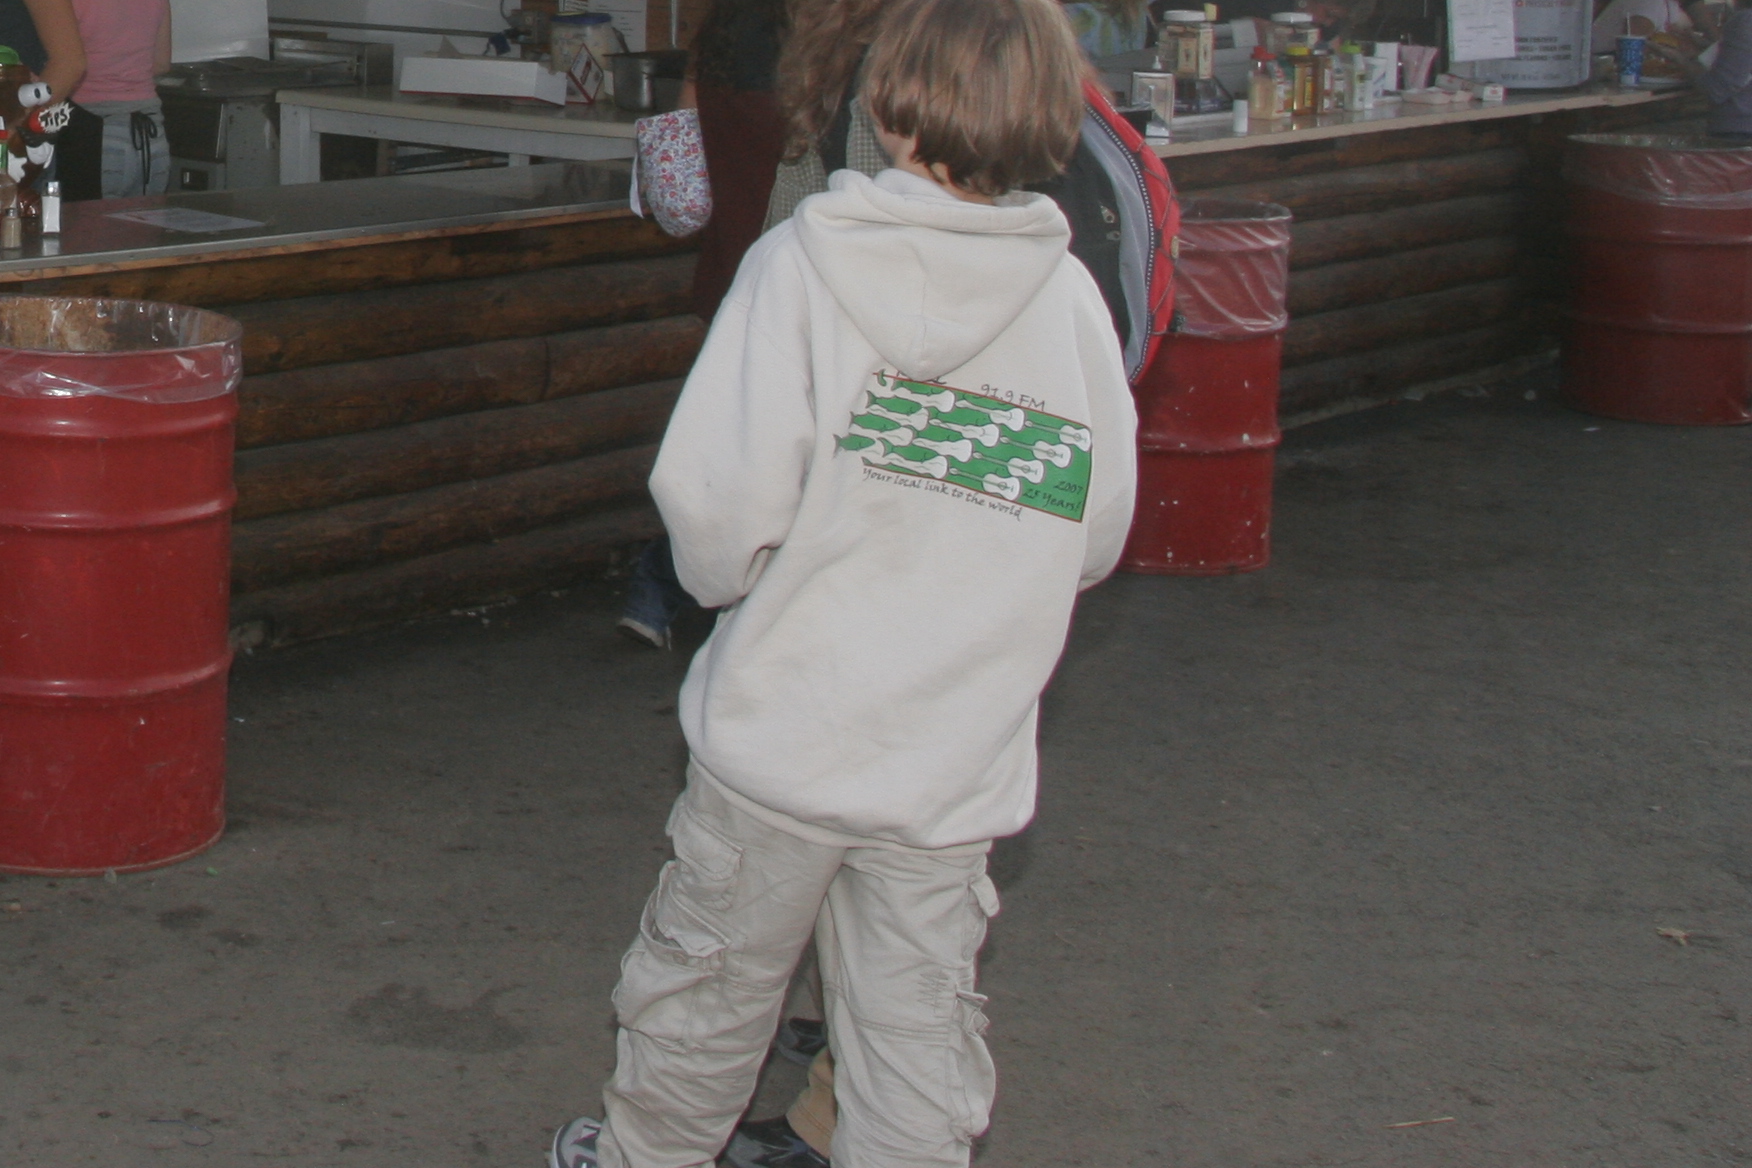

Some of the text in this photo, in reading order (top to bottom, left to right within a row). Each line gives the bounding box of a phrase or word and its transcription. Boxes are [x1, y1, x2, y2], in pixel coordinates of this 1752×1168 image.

[1018, 393, 1046, 412] FM
[893, 474, 922, 490] local
[924, 481, 949, 496] link
[950, 487, 964, 500] to
[965, 491, 986, 508] the
[988, 500, 1023, 522] world
